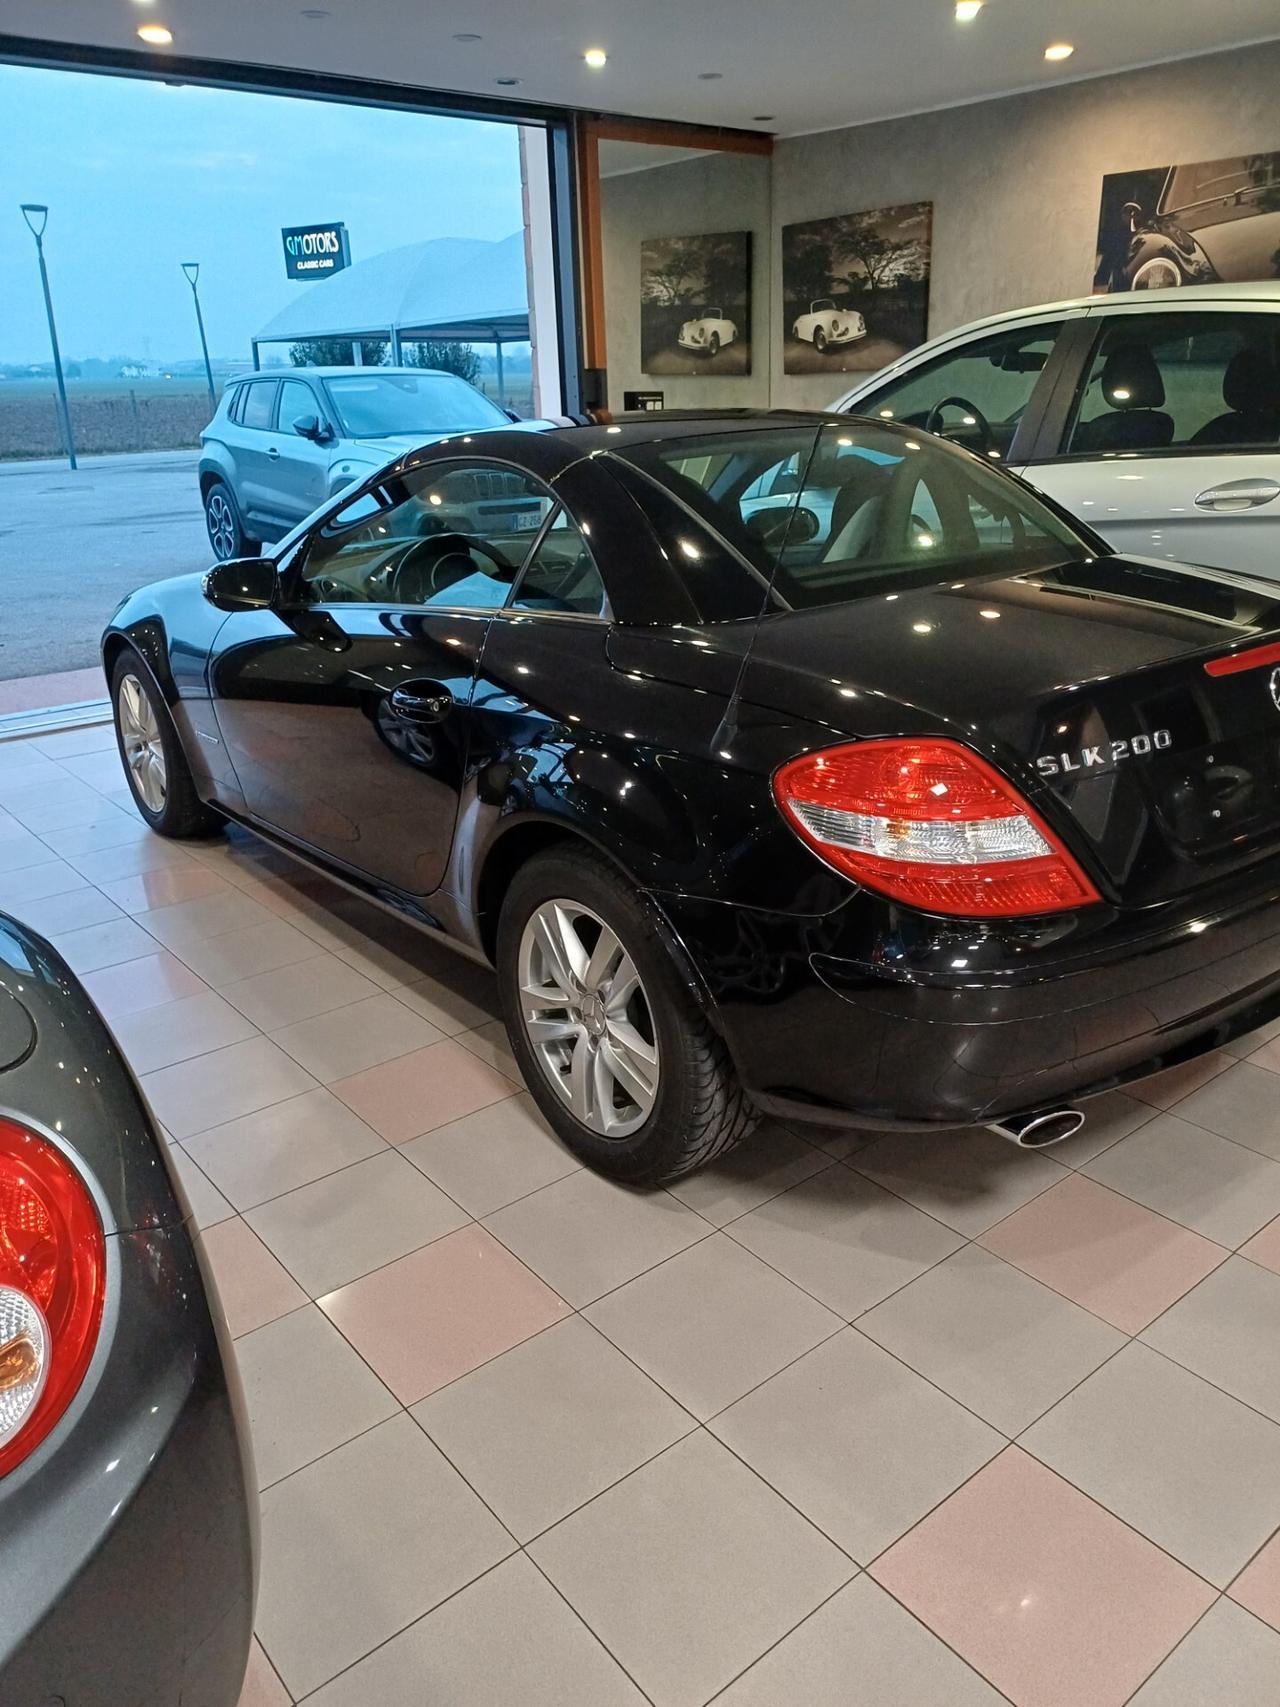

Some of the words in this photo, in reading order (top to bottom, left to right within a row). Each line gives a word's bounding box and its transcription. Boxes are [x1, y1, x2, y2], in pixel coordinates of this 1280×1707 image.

[286, 231, 339, 256] GMOTORS
[319, 259, 334, 268] CARS
[1036, 746, 1106, 776] SLK
[1110, 730, 1172, 761] 200
